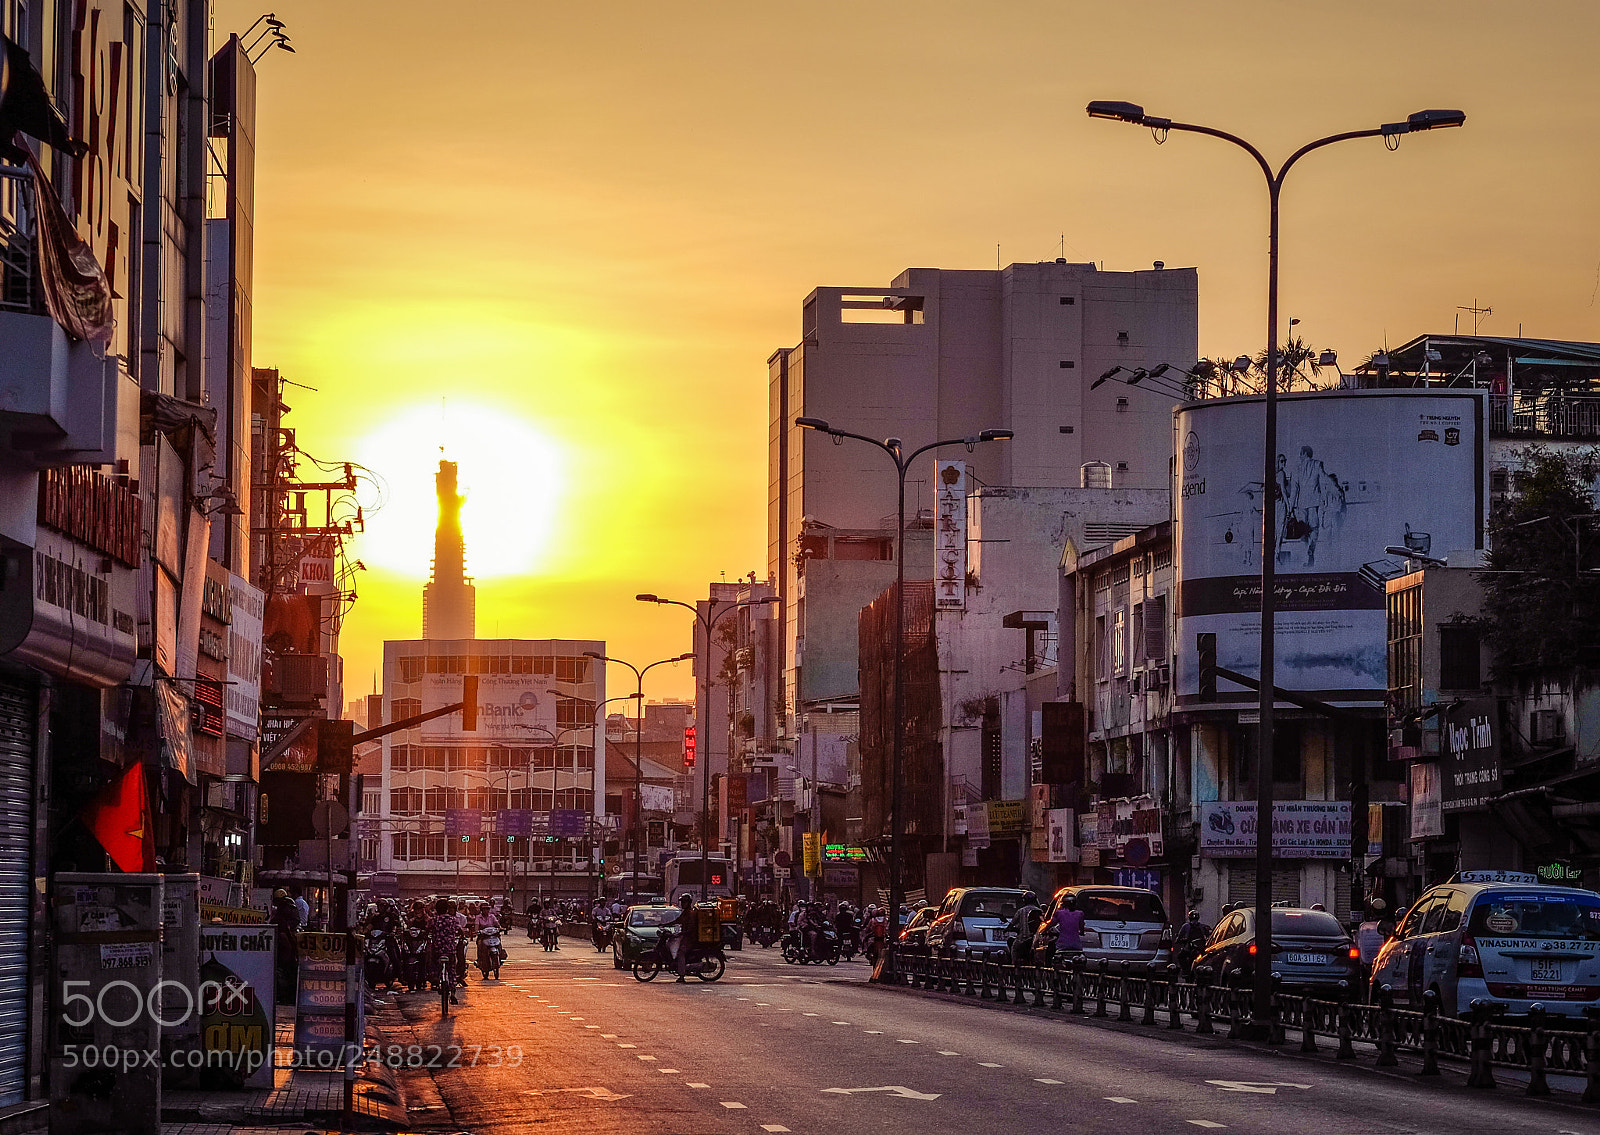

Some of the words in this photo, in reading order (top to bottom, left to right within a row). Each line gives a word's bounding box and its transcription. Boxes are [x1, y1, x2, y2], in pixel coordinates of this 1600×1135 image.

[1182, 477, 1206, 500] egend
[302, 562, 330, 581] KHOA
[262, 731, 277, 744] VIỆT
[1448, 722, 1469, 760] Ngọc
[1470, 715, 1492, 750] Trinh
[1241, 815, 1257, 834] CỬ
[1272, 816, 1294, 834] ÀNG
[1296, 819, 1311, 835] XE
[1480, 874, 1506, 882] 38.27
[240, 930, 273, 952] CHẤT
[1479, 940, 1520, 948] VINASUN
[1520, 940, 1537, 948] TAXI
[1554, 942, 1581, 950] 38.27
[1583, 942, 1595, 951] 27
